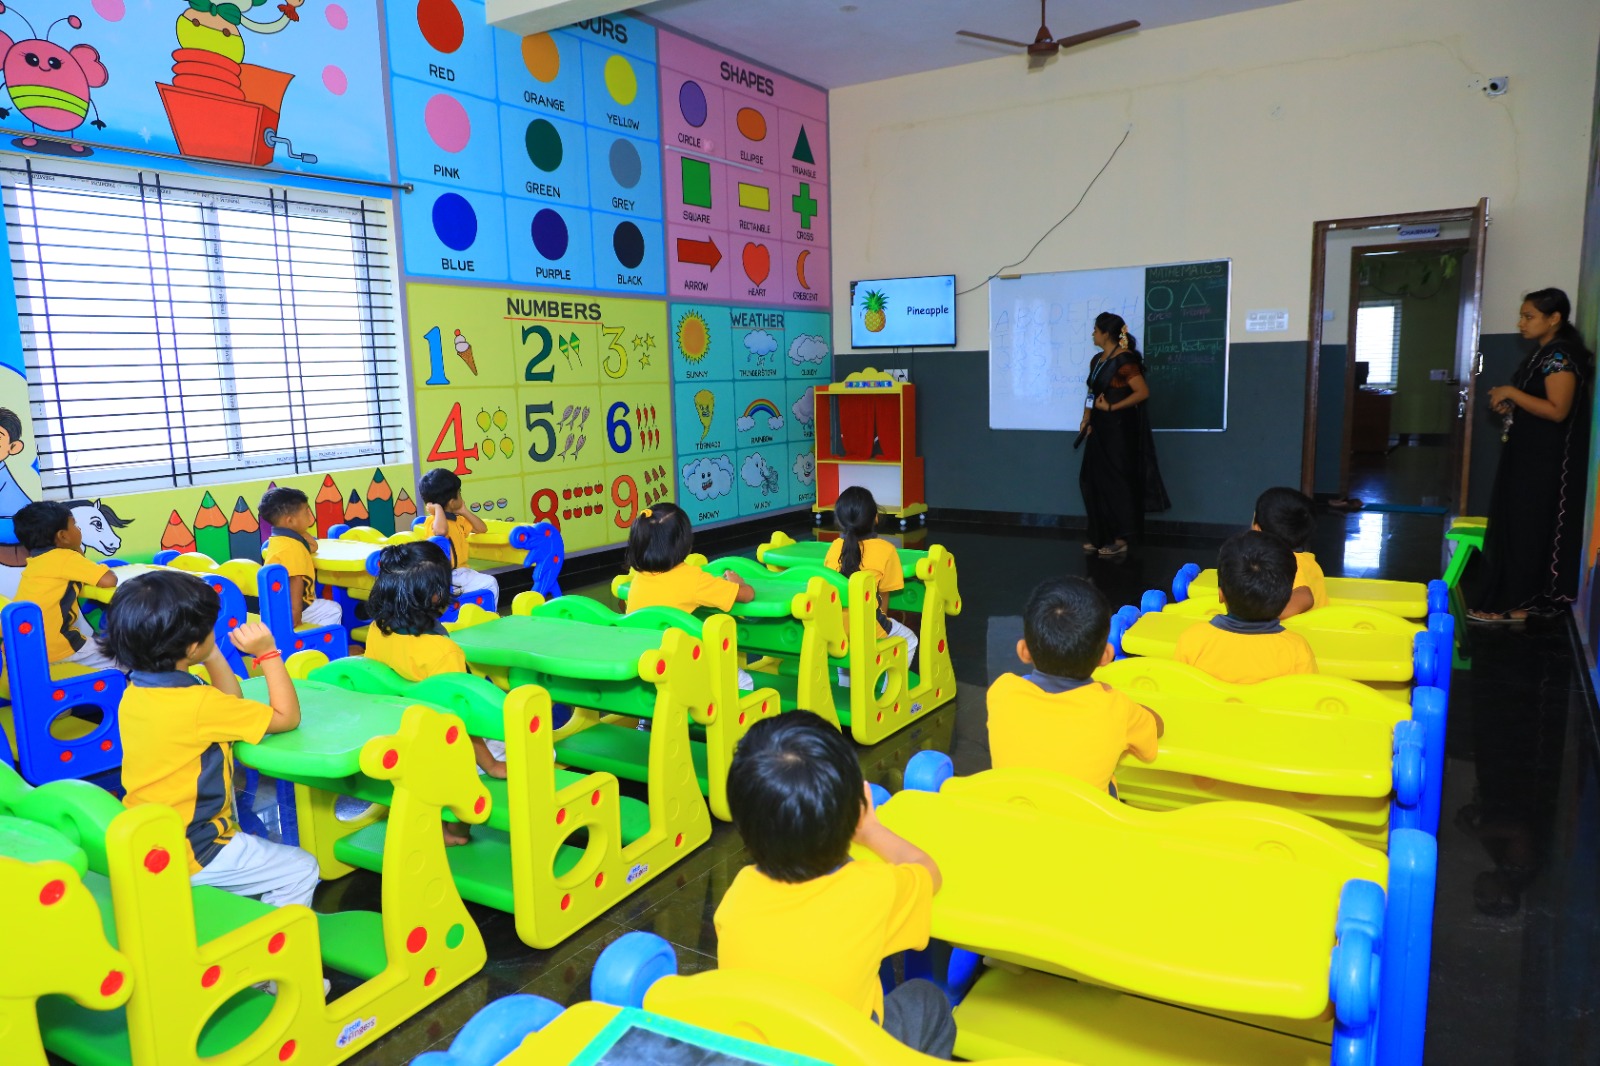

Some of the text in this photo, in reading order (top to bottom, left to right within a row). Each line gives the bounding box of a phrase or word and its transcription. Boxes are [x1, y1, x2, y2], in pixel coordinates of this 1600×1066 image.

[429, 63, 455, 82] RED
[720, 61, 774, 97] SHAPES
[523, 90, 565, 112] ORANGE
[606, 113, 640, 131] YELLOW
[677, 132, 701, 148] CIRCLE
[740, 150, 764, 165] ELLIPSE
[433, 164, 460, 180] PINK
[791, 165, 817, 179] TRIANGLE
[525, 181, 561, 199] GREEN
[611, 197, 635, 211] GREY
[683, 210, 711, 224] SQUARE
[739, 219, 771, 234] RECTANGLE
[1400, 228, 1437, 236] CHAIRMAN
[796, 230, 814, 242] CROSS
[441, 258, 475, 272] BLUE
[535, 266, 571, 281] PURPLE
[617, 273, 643, 286] BLACK
[684, 280, 708, 291] ARROW
[748, 288, 767, 297] HEART
[792, 291, 818, 301] CRESCENT
[506, 297, 602, 320] NUMBERS
[906, 304, 949, 317] Pineapple
[730, 311, 785, 328] WEATHER
[424, 325, 450, 385] 1
[521, 324, 555, 382] 2
[601, 323, 628, 379] 3
[686, 370, 708, 378] SUNNY
[739, 369, 777, 377] THUNDERSTORM
[525, 401, 557, 462] 5
[606, 401, 632, 453] 6
[427, 402, 479, 475] 4
[696, 441, 721, 450] TORNADO
[751, 435, 773, 444] RAINBOW
[611, 474, 638, 528] 9
[753, 501, 772, 509] WINDY
[530, 488, 561, 534] 8
[698, 510, 720, 521] SNOWY
